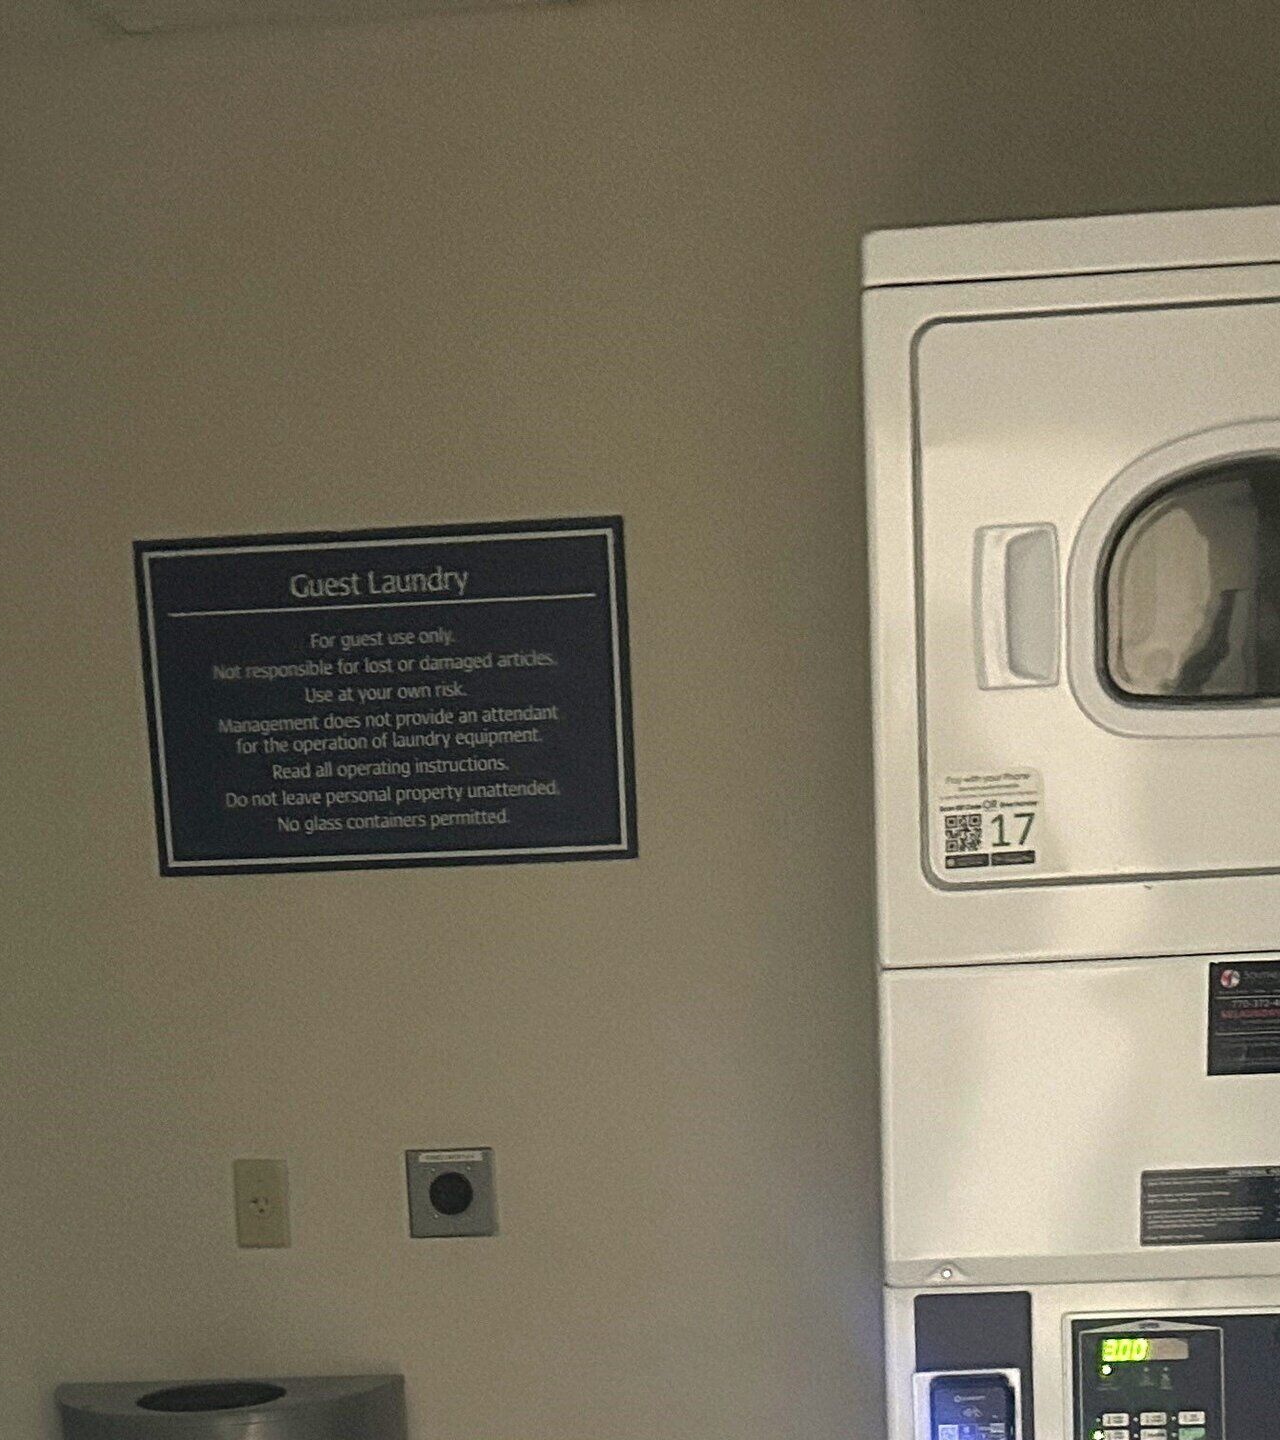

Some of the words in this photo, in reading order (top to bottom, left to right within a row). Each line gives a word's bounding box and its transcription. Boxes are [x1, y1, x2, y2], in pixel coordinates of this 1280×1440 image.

[289, 571, 361, 598] Guest
[367, 566, 468, 597] Laundry
[310, 633, 335, 649] For
[341, 631, 384, 651] guest
[388, 632, 413, 646] use
[419, 627, 454, 646] only.
[213, 665, 242, 679] Not
[245, 659, 332, 681] responsible
[338, 659, 359, 674] for
[364, 656, 393, 673] lost
[398, 659, 413, 671] or
[419, 652, 492, 673] damaged
[497, 650, 558, 668] articles.
[305, 687, 334, 703] Use
[338, 688, 354, 702] at
[358, 687, 391, 705] your
[398, 686, 430, 699] own
[435, 681, 468, 698] risk.
[219, 714, 320, 736] Management
[324, 714, 361, 729] does
[365, 713, 392, 728] not
[396, 709, 453, 728] provide
[459, 710, 477, 723] an
[482, 705, 559, 722] attendant
[236, 738, 259, 754] for
[263, 736, 288, 752] the
[293, 733, 368, 755] operation
[372, 732, 388, 749] of
[392, 730, 450, 749] laundry
[455, 728, 542, 747] equipment.
[272, 764, 310, 779] Read
[315, 761, 332, 777] all
[337, 759, 411, 780] operating
[415, 756, 510, 774] instructions.
[226, 792, 248, 808] Do
[252, 791, 279, 806] not
[283, 790, 321, 805] leave
[326, 787, 392, 807] personal
[396, 785, 462, 805] property
[467, 780, 560, 798] unattended.
[277, 817, 299, 832] No
[304, 814, 343, 835] glass
[346, 811, 426, 830] containers
[430, 808, 510, 829] permitted.
[991, 813, 1035, 846] 17
